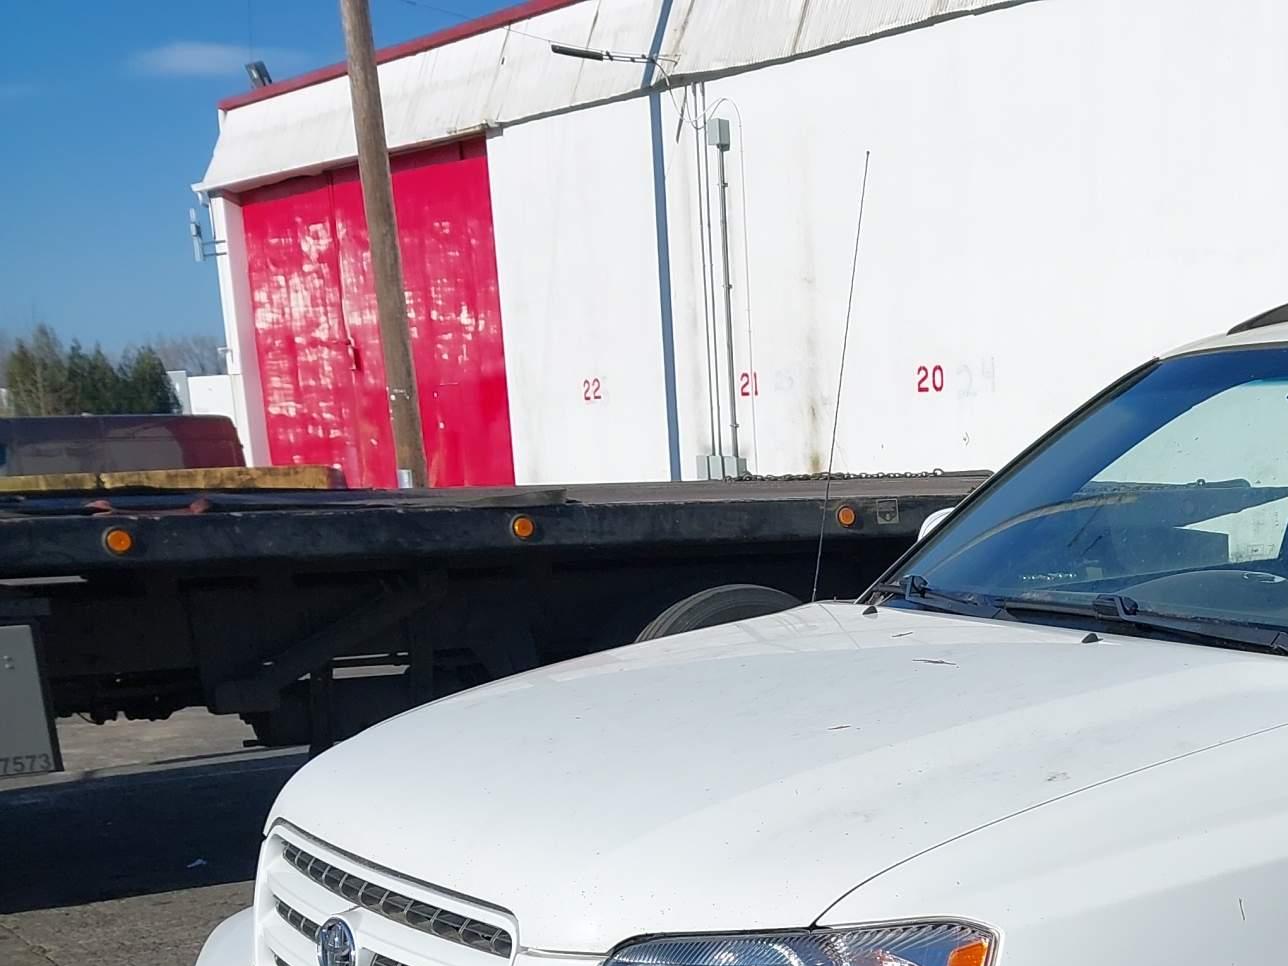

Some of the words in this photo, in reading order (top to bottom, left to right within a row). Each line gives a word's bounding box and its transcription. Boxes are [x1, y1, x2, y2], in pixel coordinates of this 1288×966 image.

[583, 378, 602, 400] 22
[740, 372, 759, 396] 21
[917, 364, 945, 393] 20
